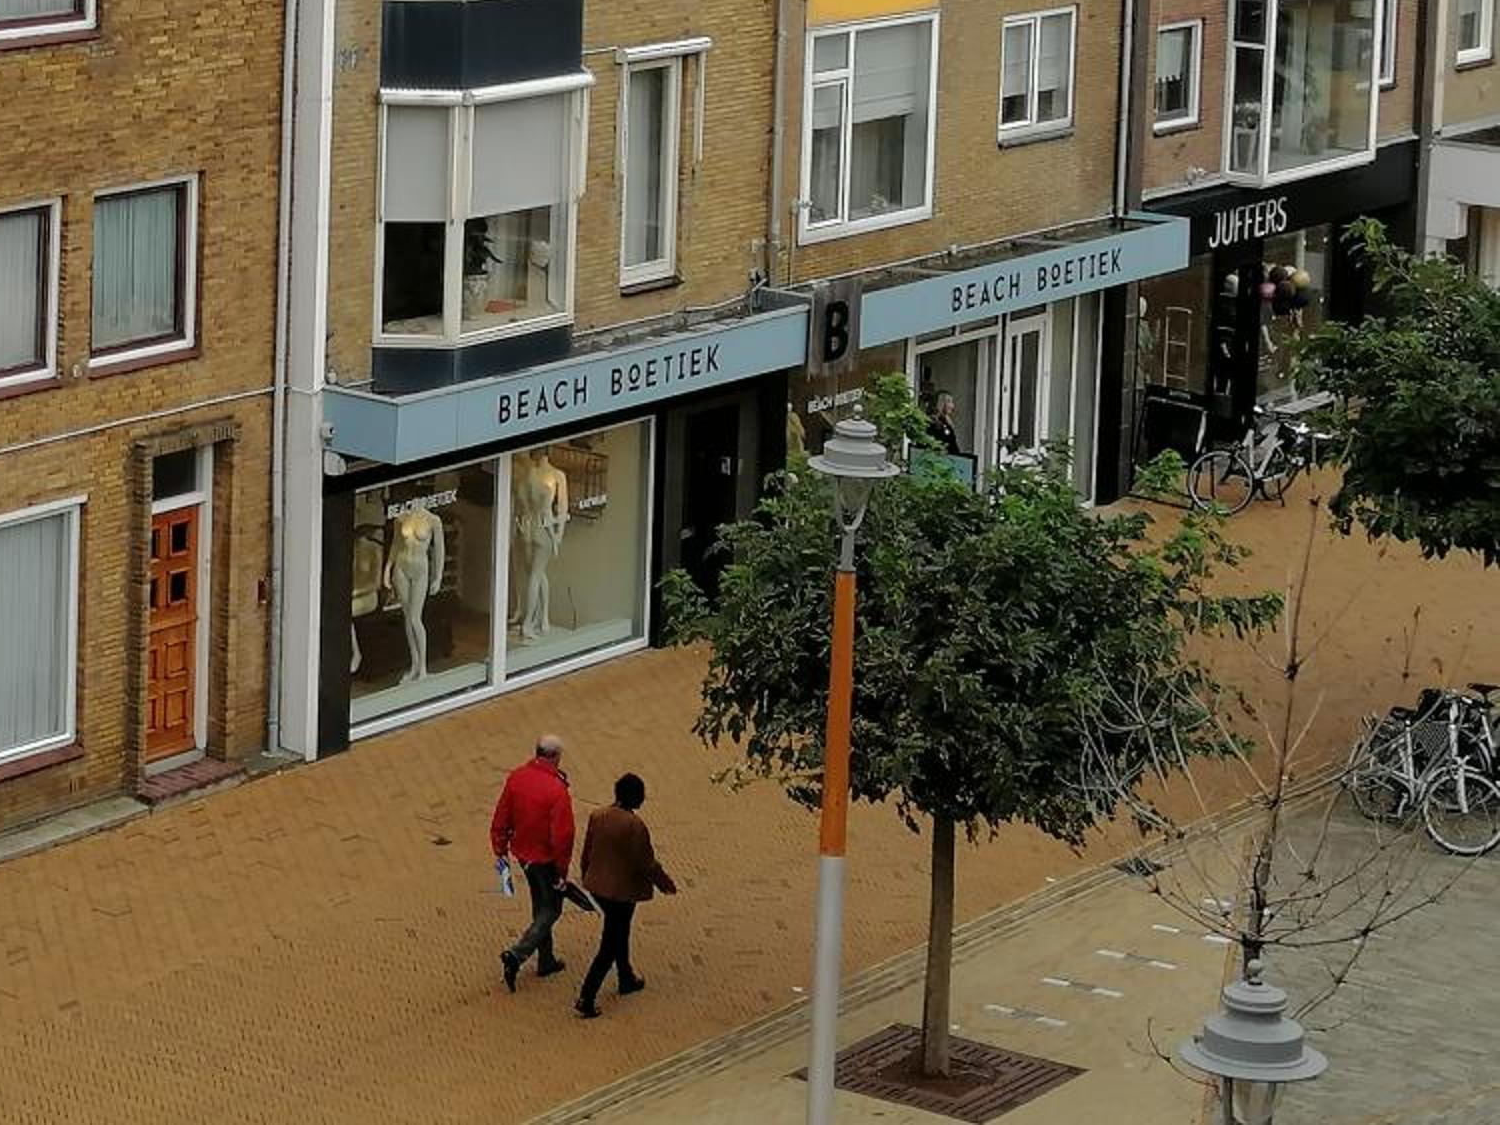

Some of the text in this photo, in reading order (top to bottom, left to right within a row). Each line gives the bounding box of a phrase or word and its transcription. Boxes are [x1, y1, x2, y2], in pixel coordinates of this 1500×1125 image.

[1209, 197, 1288, 248] JUFFERS
[951, 248, 1122, 313] BEACH BOETIEK
[824, 300, 850, 363] B
[499, 344, 719, 424] BEACH BOETIEK
